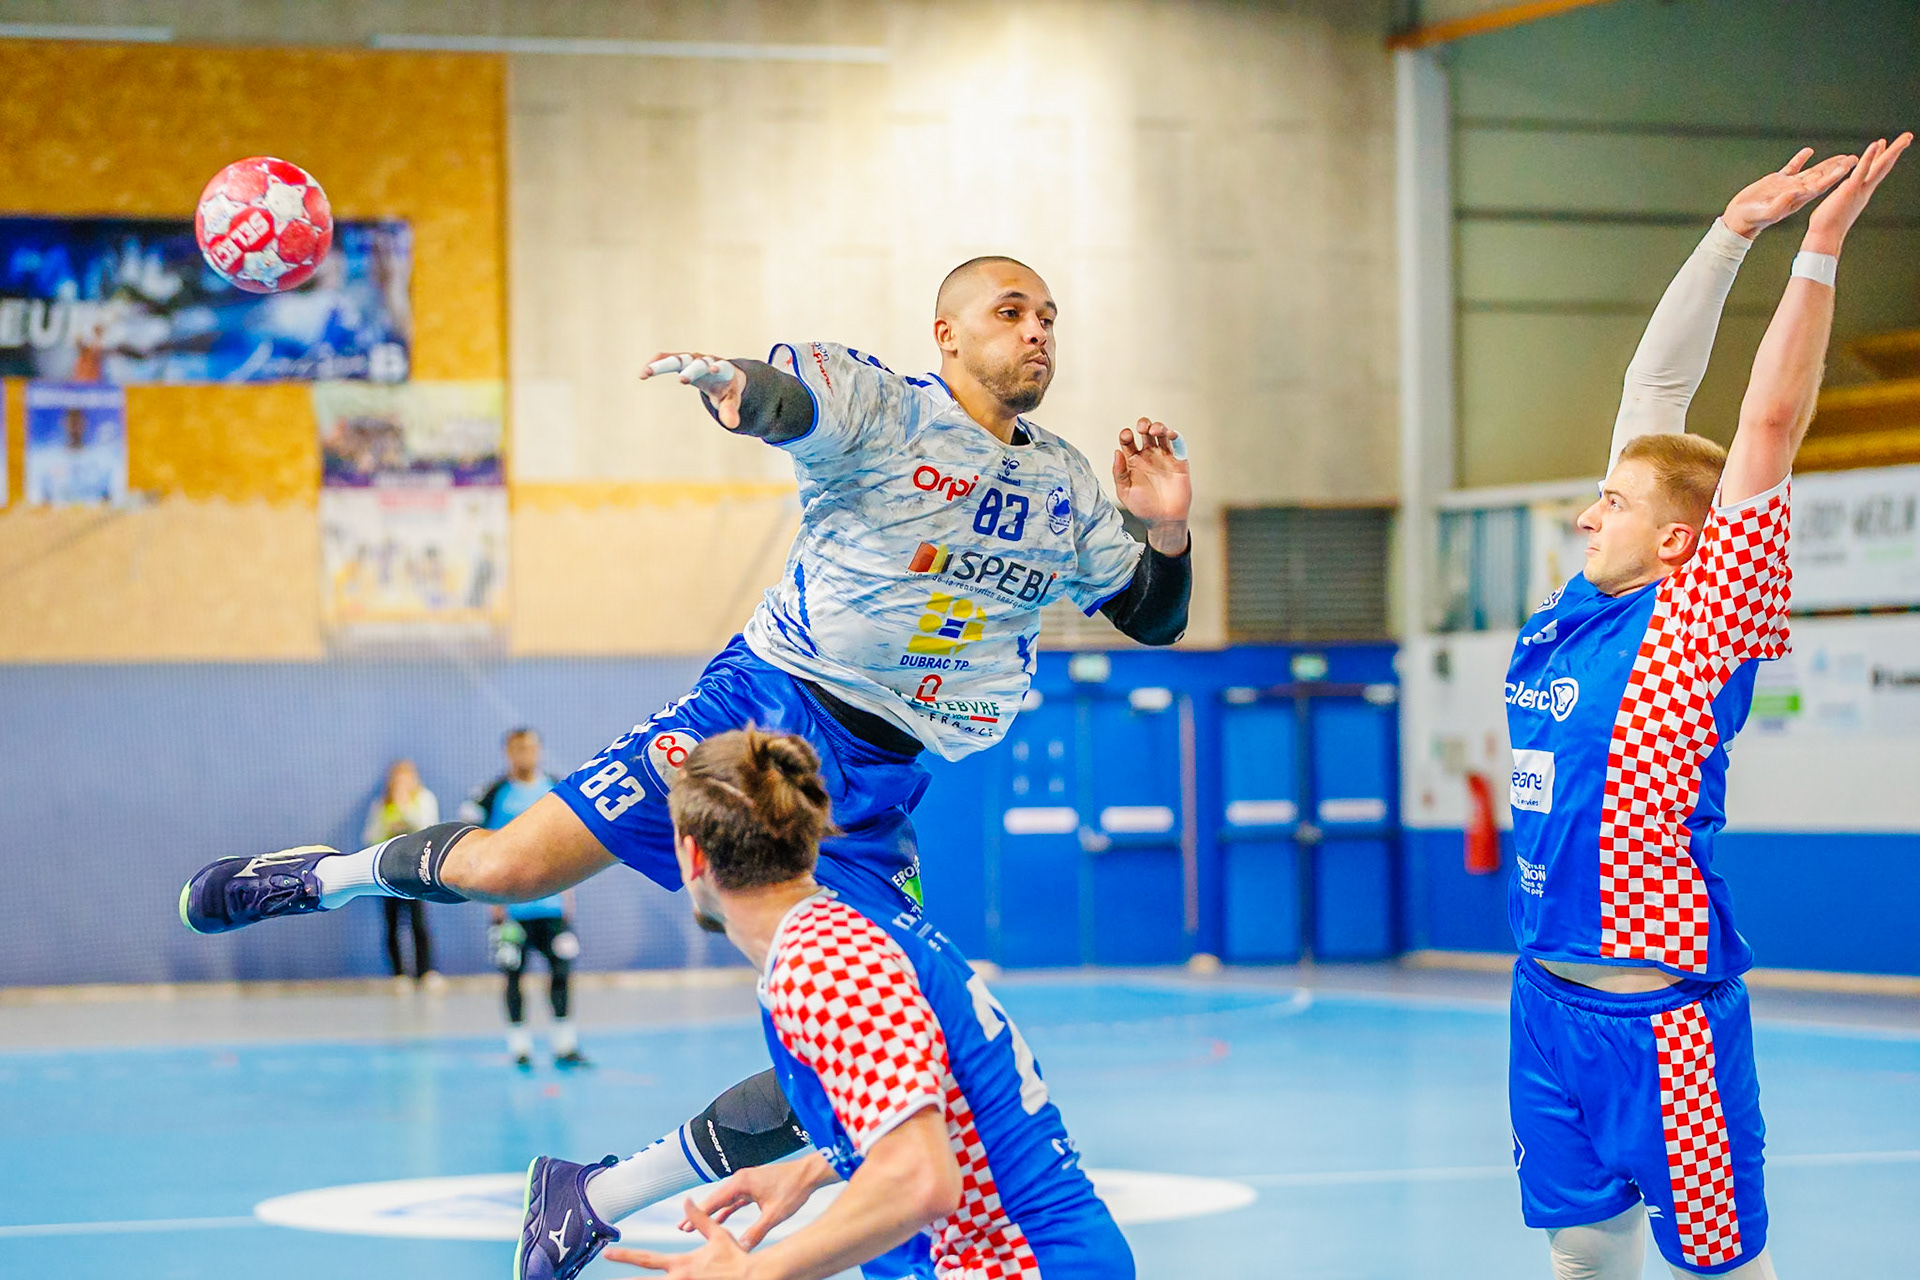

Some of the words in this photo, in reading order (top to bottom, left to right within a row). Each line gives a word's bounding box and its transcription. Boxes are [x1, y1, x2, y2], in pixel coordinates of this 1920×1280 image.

[912, 465, 979, 501] Orpi
[973, 487, 1029, 541] 83
[900, 655, 951, 670] DUBRAC
[954, 660, 969, 671] TP
[579, 760, 646, 822] 83
